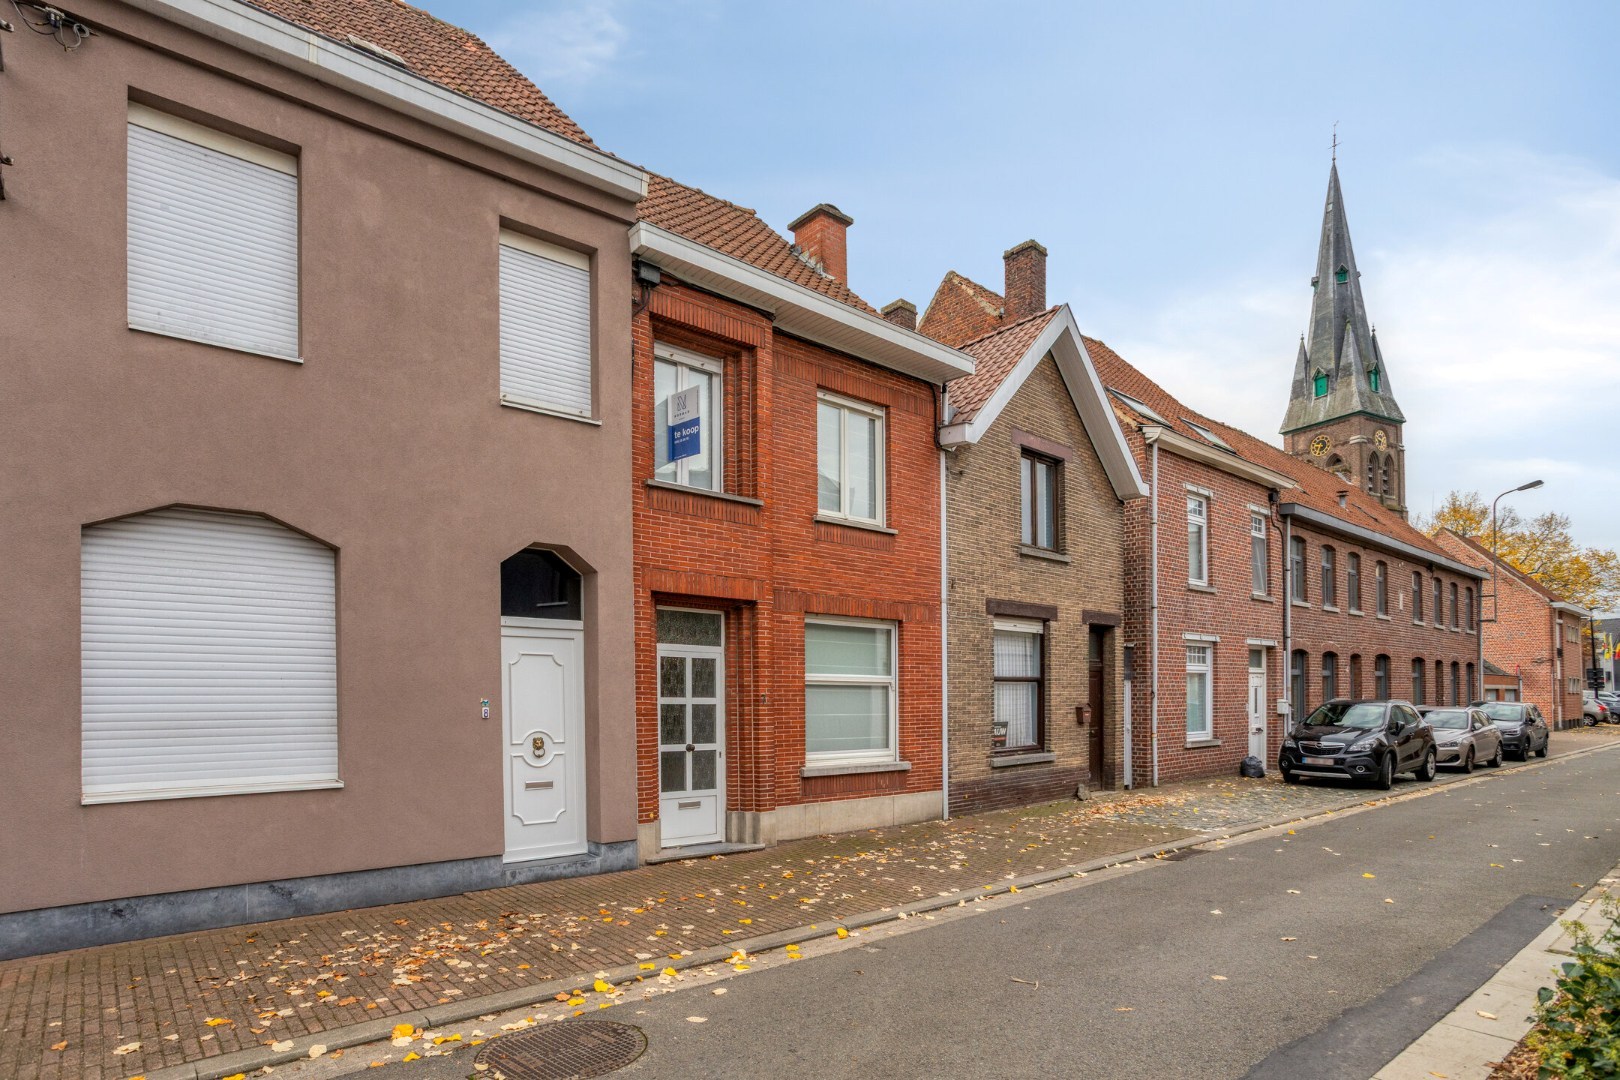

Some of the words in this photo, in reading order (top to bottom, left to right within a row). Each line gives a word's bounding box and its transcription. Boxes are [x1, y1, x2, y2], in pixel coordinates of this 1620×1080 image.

[674, 431, 681, 439] te
[682, 425, 700, 437] koop
[483, 708, 489, 718] 8
